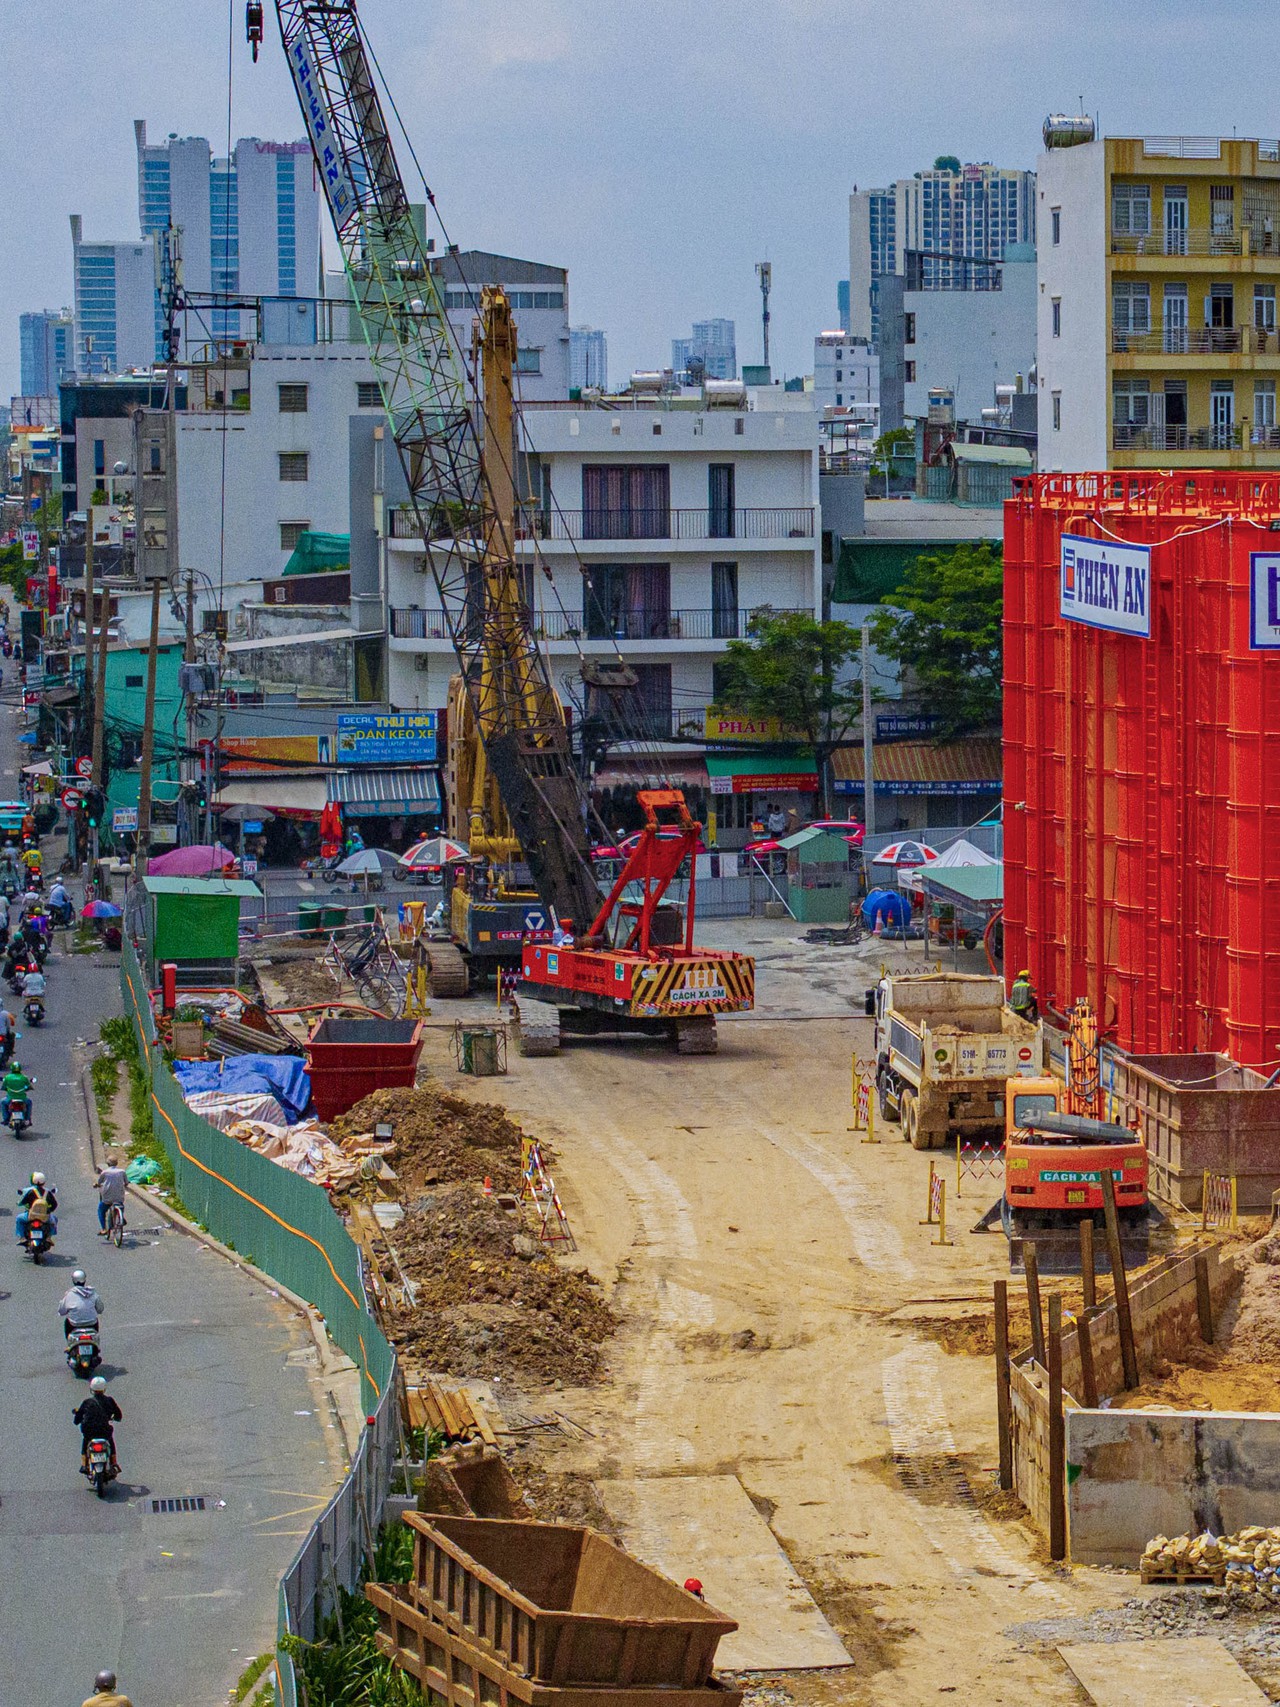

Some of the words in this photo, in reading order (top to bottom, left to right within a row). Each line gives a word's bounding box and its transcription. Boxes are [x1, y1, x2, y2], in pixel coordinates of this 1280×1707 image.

[1076, 551, 1120, 612] THIÊN
[1123, 566, 1146, 616] AN
[343, 716, 374, 724] DECAL
[374, 716, 405, 728] THU
[418, 729, 435, 739] XE
[684, 969, 719, 989] IHI
[672, 990, 697, 1001] CÁCH
[698, 990, 710, 999] XA
[711, 989, 725, 998] 2M
[1043, 1172, 1077, 1182] CÁCH
[1080, 1173, 1096, 1182] XA
